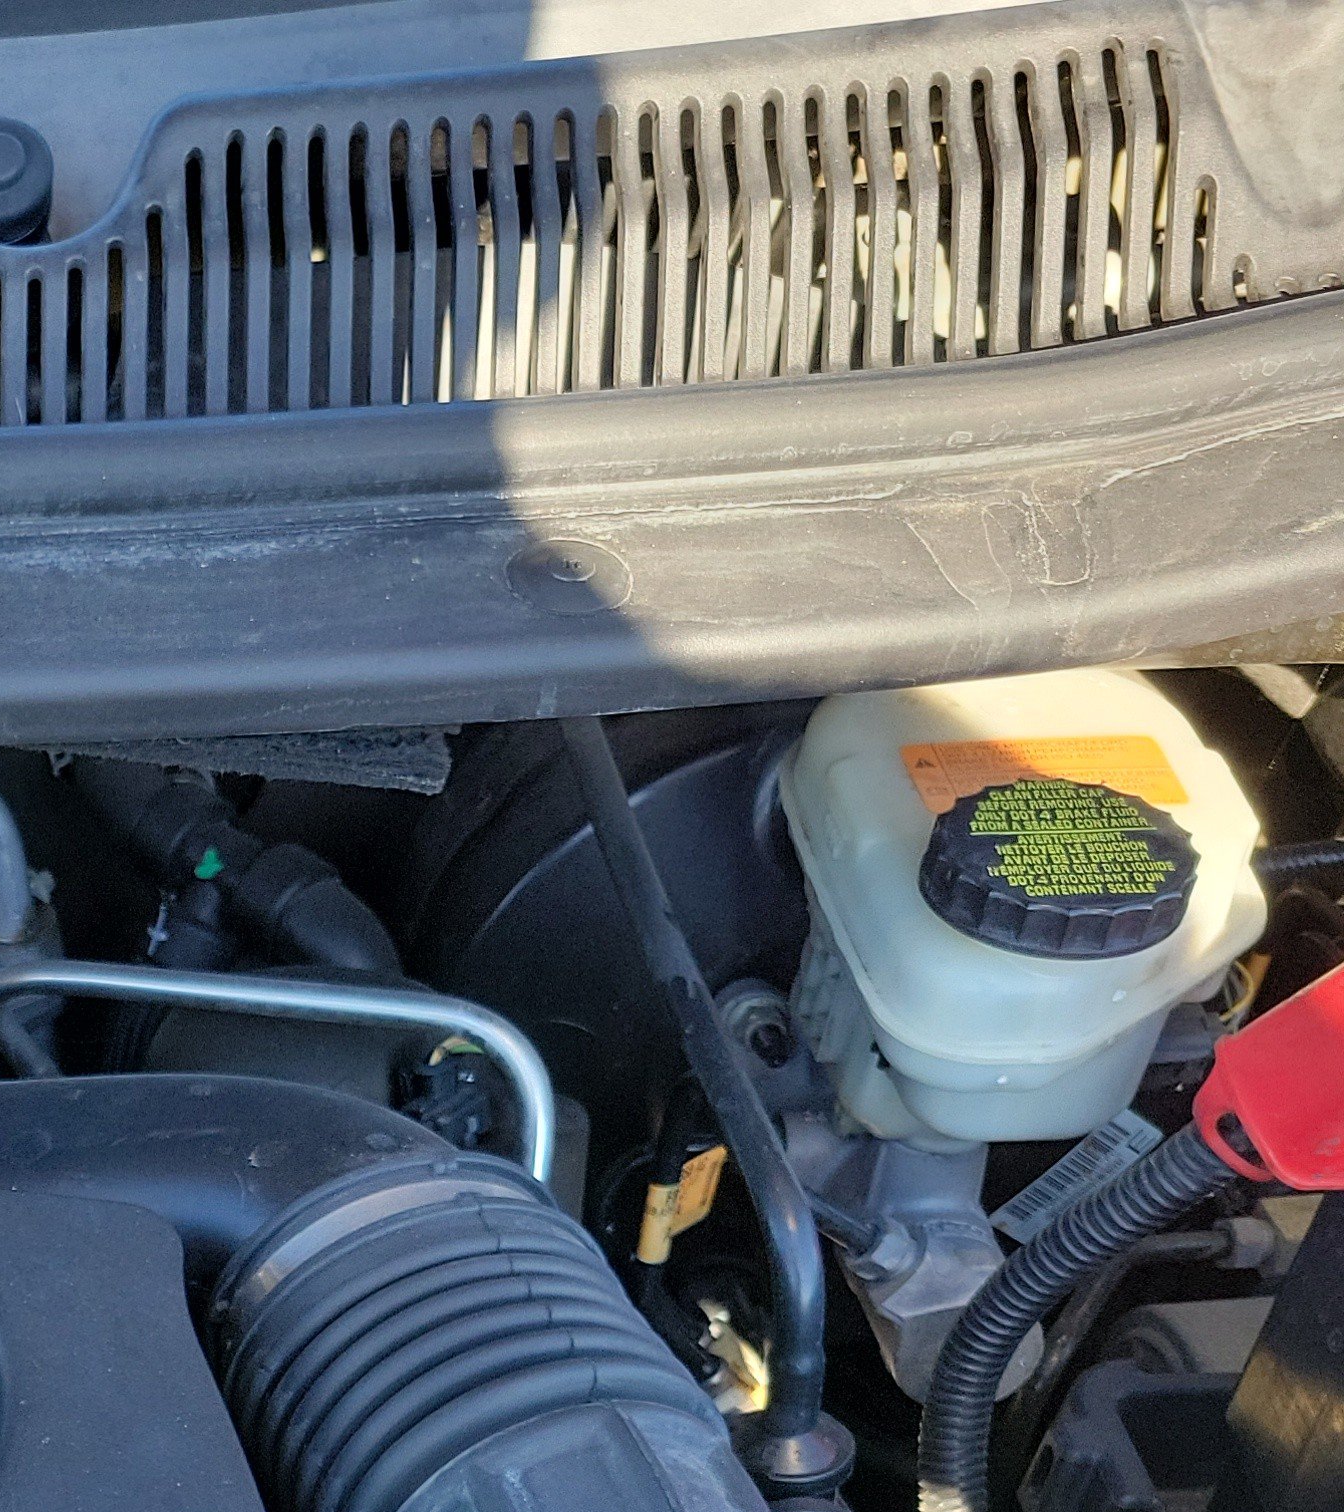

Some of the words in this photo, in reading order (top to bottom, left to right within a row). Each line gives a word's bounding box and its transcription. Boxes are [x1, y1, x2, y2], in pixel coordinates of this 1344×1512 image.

[989, 790, 1031, 801] CLEAN
[1032, 789, 1077, 800] FILLER
[1078, 788, 1105, 798] CAP
[977, 800, 1027, 811] BEFORE
[1101, 797, 1128, 808] USE
[974, 810, 1007, 821] ONLY
[1010, 810, 1036, 821] DOT
[1039, 810, 1052, 820] 4
[1055, 808, 1100, 819] BRAKE
[1101, 806, 1139, 818] FLUID
[969, 820, 1009, 832] FROM
[1011, 820, 1022, 831] A
[1023, 819, 1073, 831] SEALED
[1067, 843, 1085, 853] LE
[1085, 841, 1149, 852] BOUCHON
[1004, 854, 1047, 865] AVANT
[1050, 854, 1070, 864] DE
[1071, 853, 1088, 863] LE
[1072, 863, 1100, 873] QUE
[1102, 863, 1122, 873] DU
[1123, 861, 1175, 872] LIQUIDE
[1007, 875, 1035, 886] DOT
[1050, 872, 1130, 884] PROVENANT
[1025, 883, 1104, 896] CONTENANT
[1107, 882, 1157, 893] SCELLE
